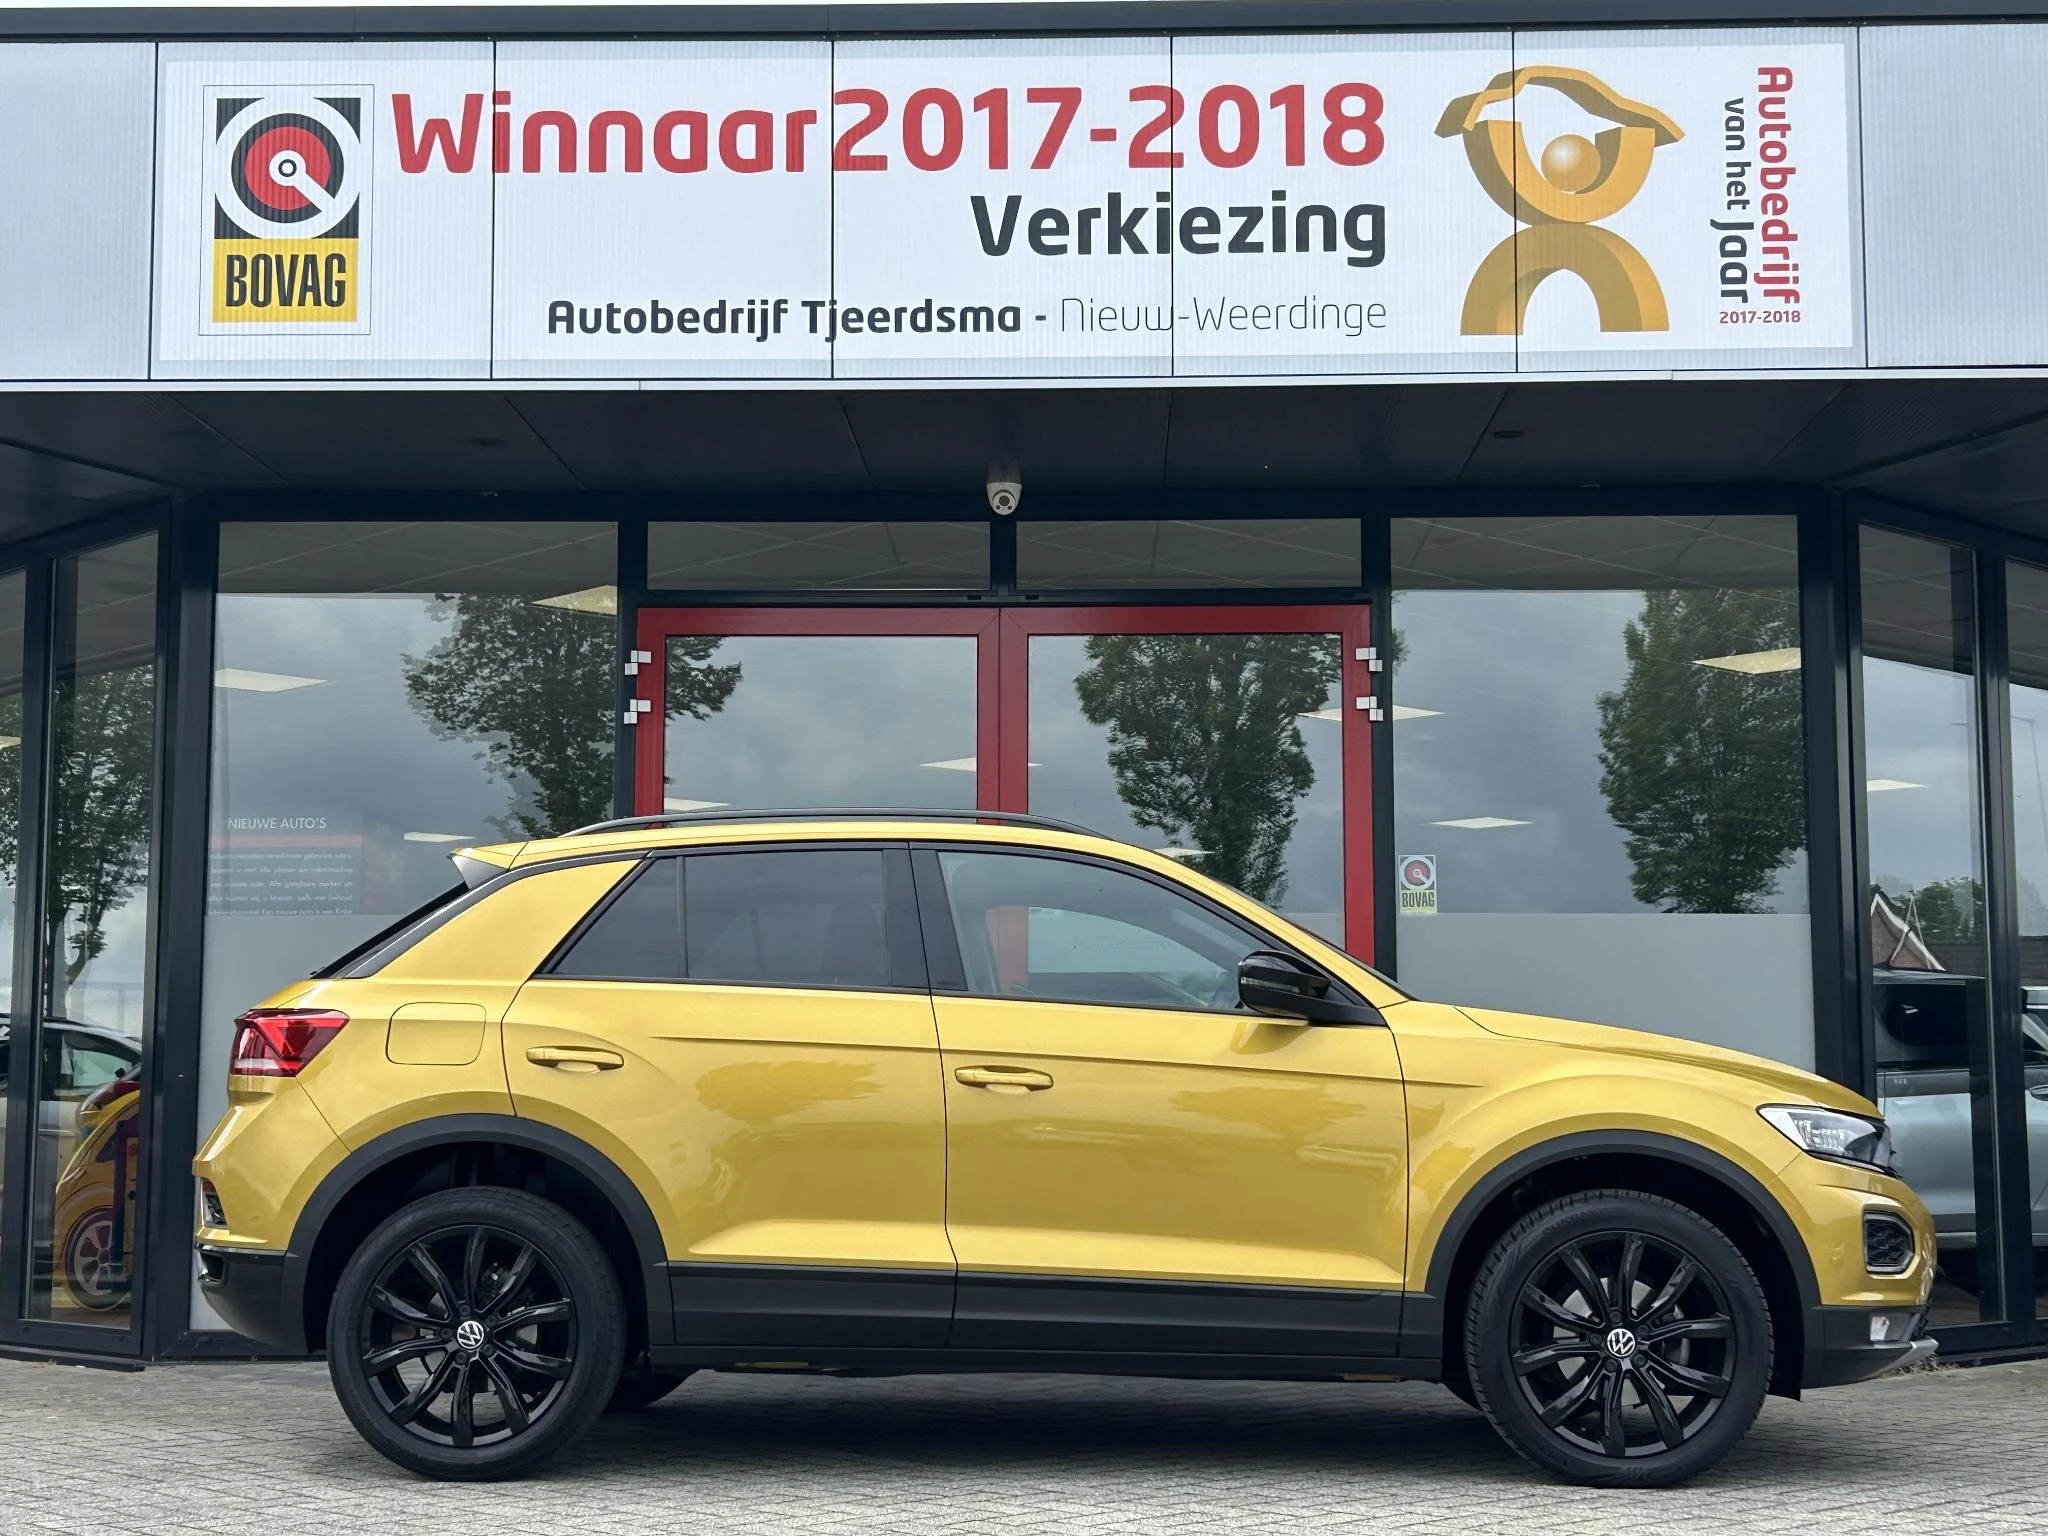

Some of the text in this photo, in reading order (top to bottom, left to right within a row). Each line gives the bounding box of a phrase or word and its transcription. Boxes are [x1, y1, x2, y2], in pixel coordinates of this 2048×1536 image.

[392, 82, 1385, 174] Winnaar 2017-2018
[1725, 97, 1745, 151] van
[1726, 162, 1751, 210] het
[1754, 67, 1801, 303] Autobedrijf
[971, 190, 1386, 267] Verkiezing
[225, 253, 346, 308] BOVAG
[548, 299, 788, 342] Autobedrijf
[801, 298, 1021, 343] Tjeerdsma
[1061, 296, 1387, 337] Nieuw-Weerdinge
[1719, 310, 1801, 324] 2017-2018
[228, 817, 327, 829] NIEUWE AUTO'S
[1402, 892, 1435, 907] BOVAG
